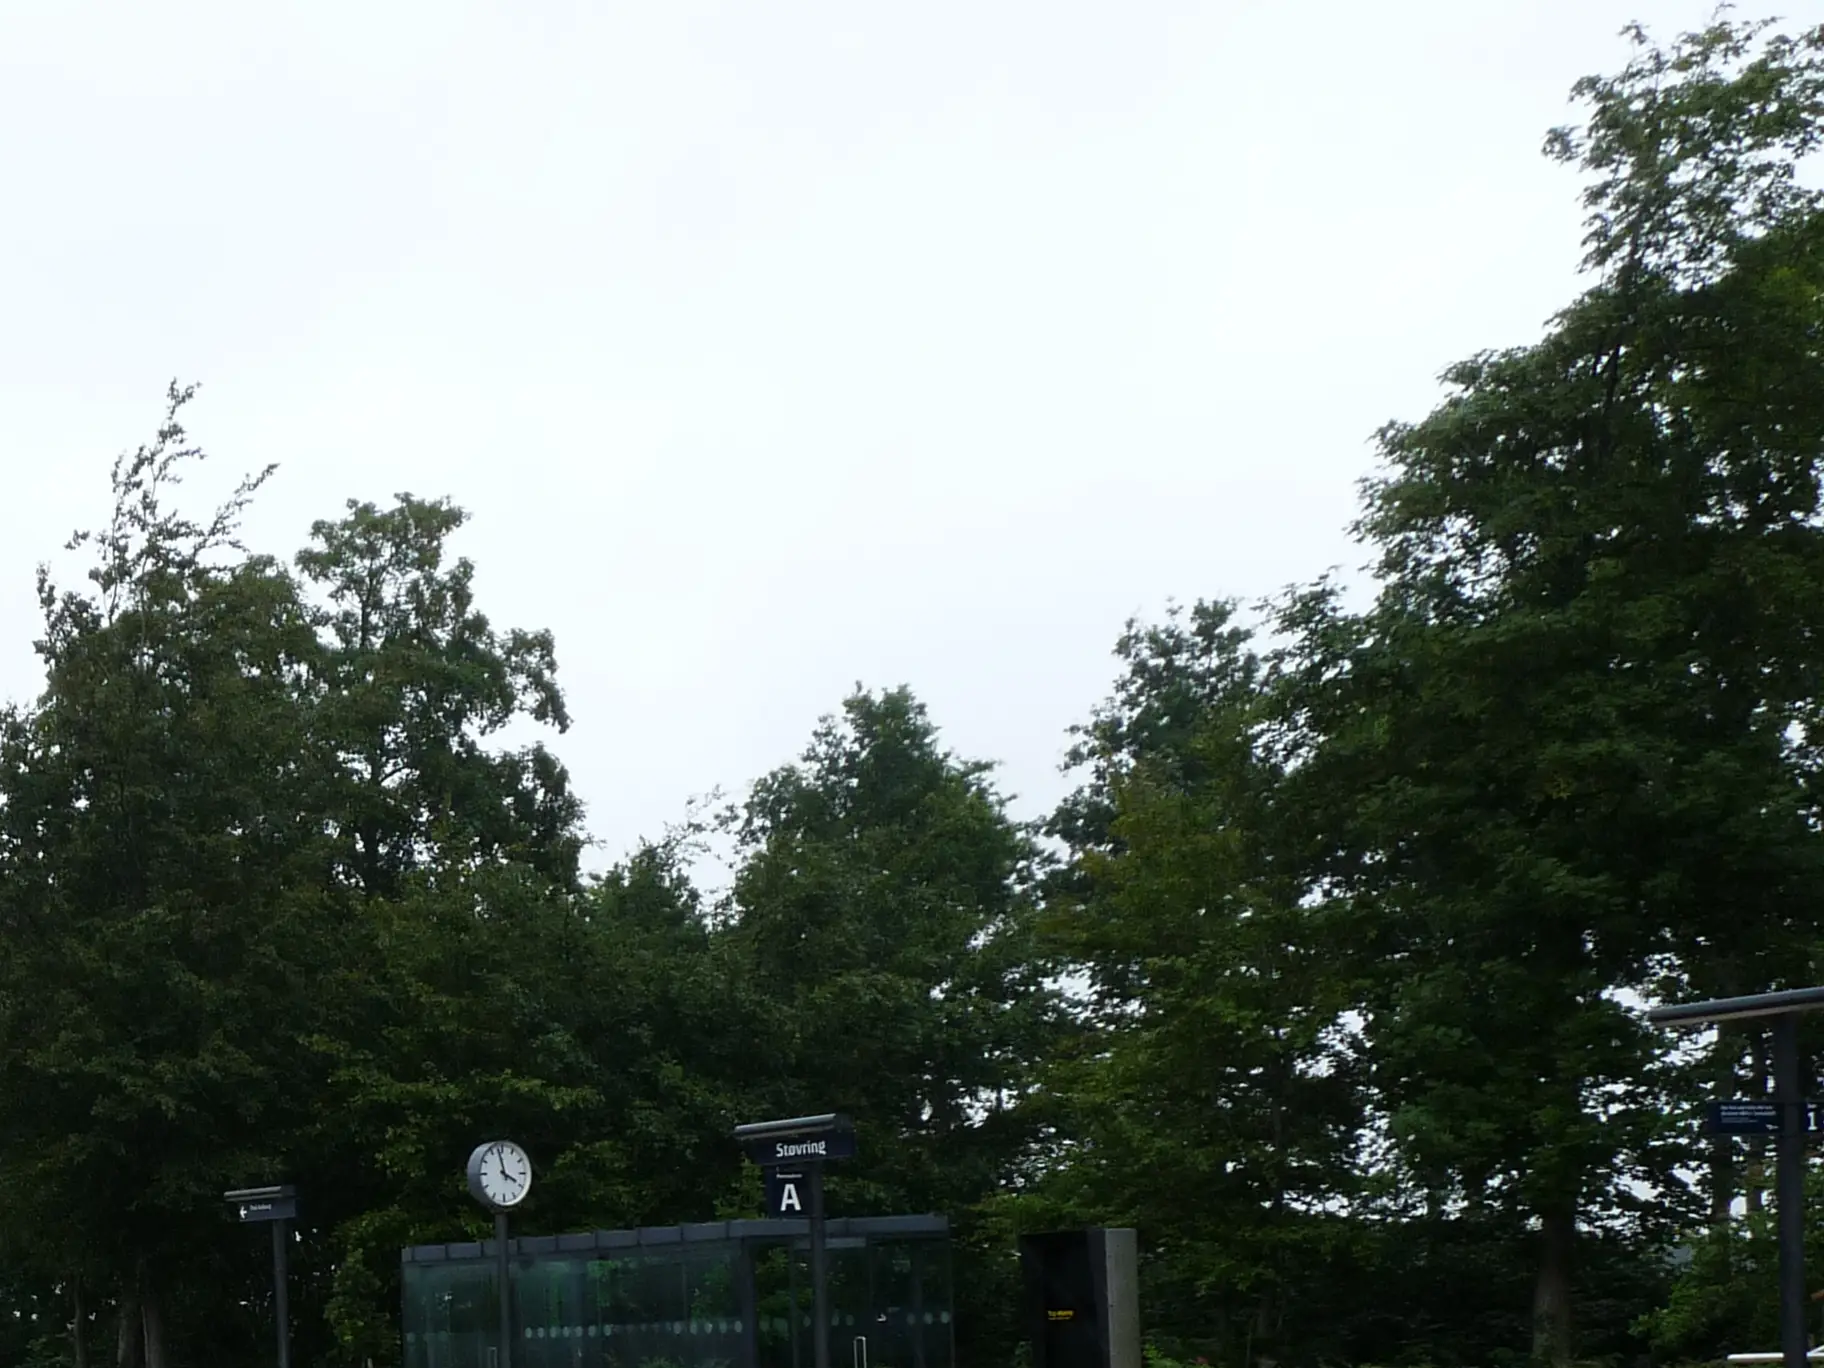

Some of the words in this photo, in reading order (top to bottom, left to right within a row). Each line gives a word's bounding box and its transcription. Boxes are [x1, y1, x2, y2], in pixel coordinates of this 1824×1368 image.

[1808, 1112, 1817, 1130] 1
[776, 1140, 827, 1157] Støvring
[780, 1184, 802, 1211] A
